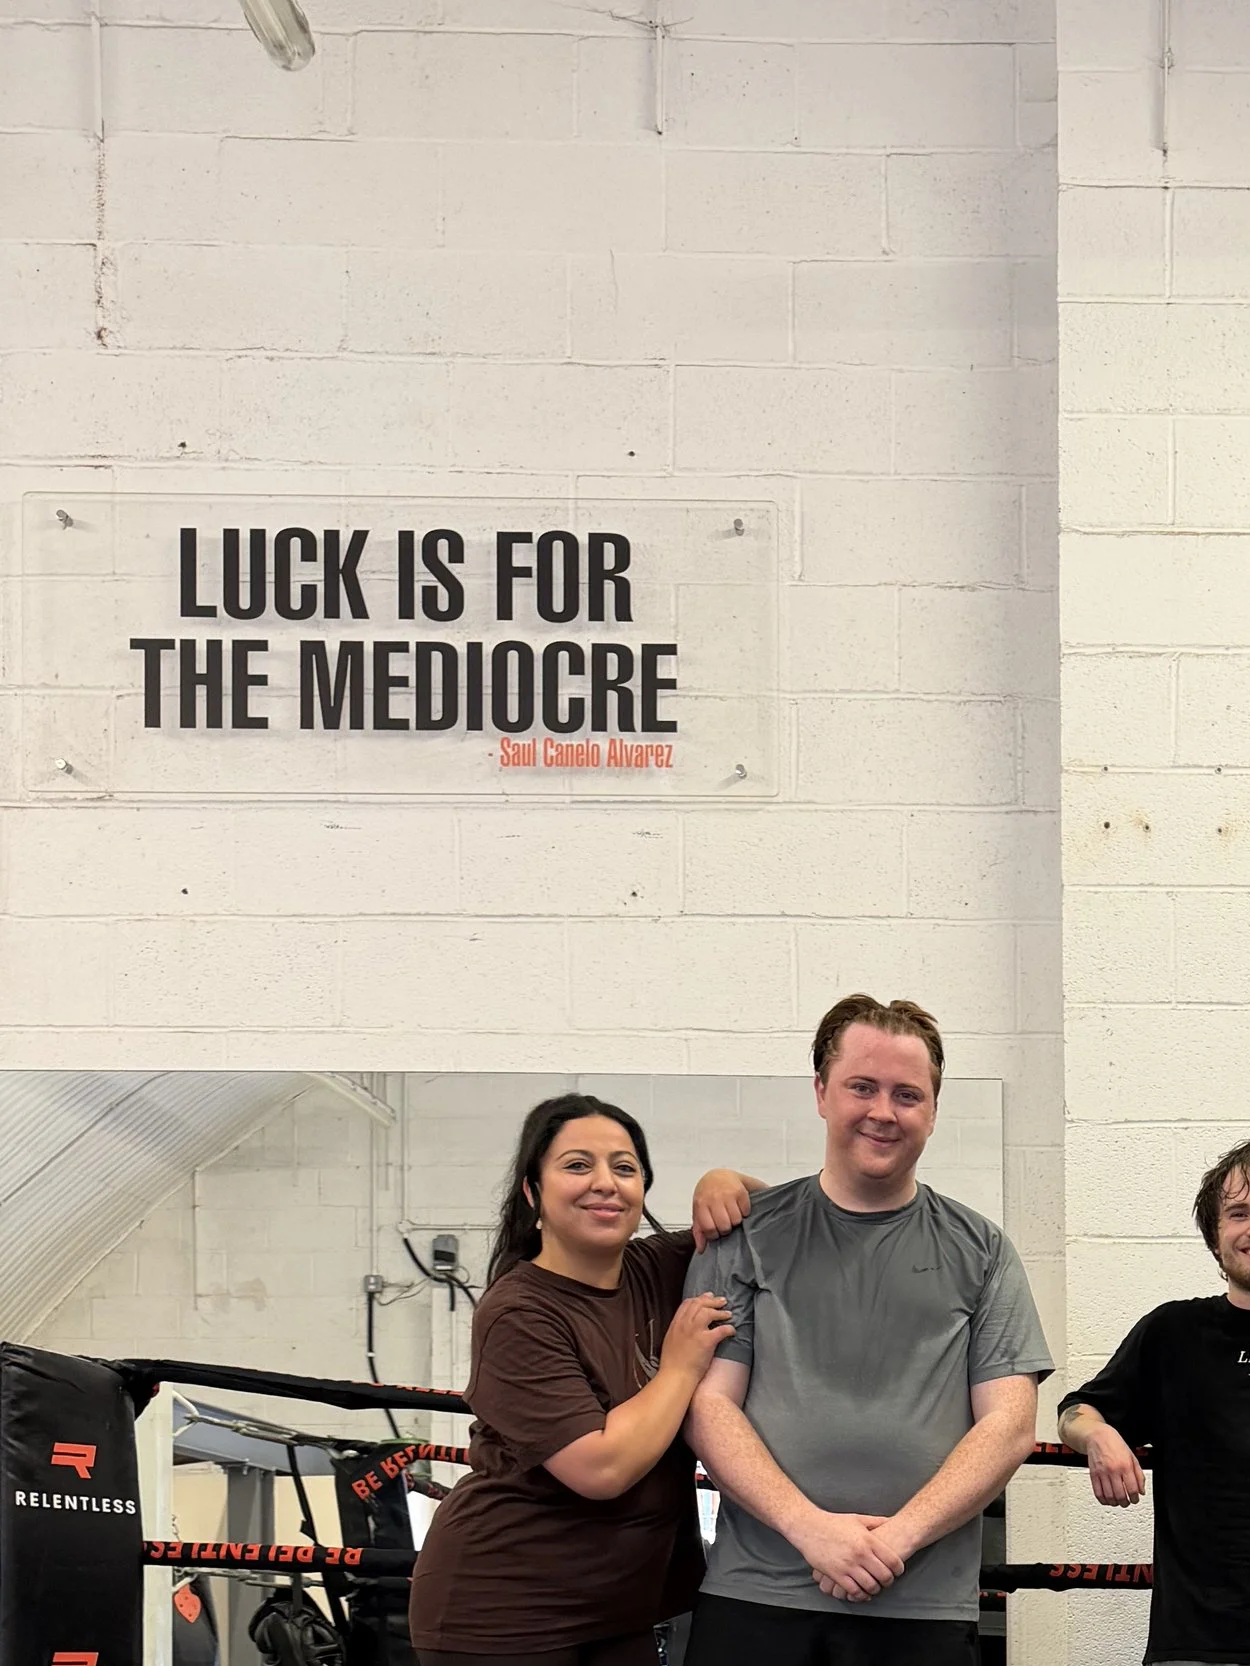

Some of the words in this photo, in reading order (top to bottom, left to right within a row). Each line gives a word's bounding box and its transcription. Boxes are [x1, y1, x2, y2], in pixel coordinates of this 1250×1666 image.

[181, 528, 369, 620] LUCK
[399, 529, 464, 621] IS
[497, 531, 632, 623] FOR
[130, 639, 268, 729] THE
[301, 641, 677, 733] MEDIOCRE
[499, 736, 537, 768] Saul
[542, 736, 601, 768] Canelo
[605, 738, 674, 769] Alvarez
[15, 1490, 137, 1515] RELENTLESS
